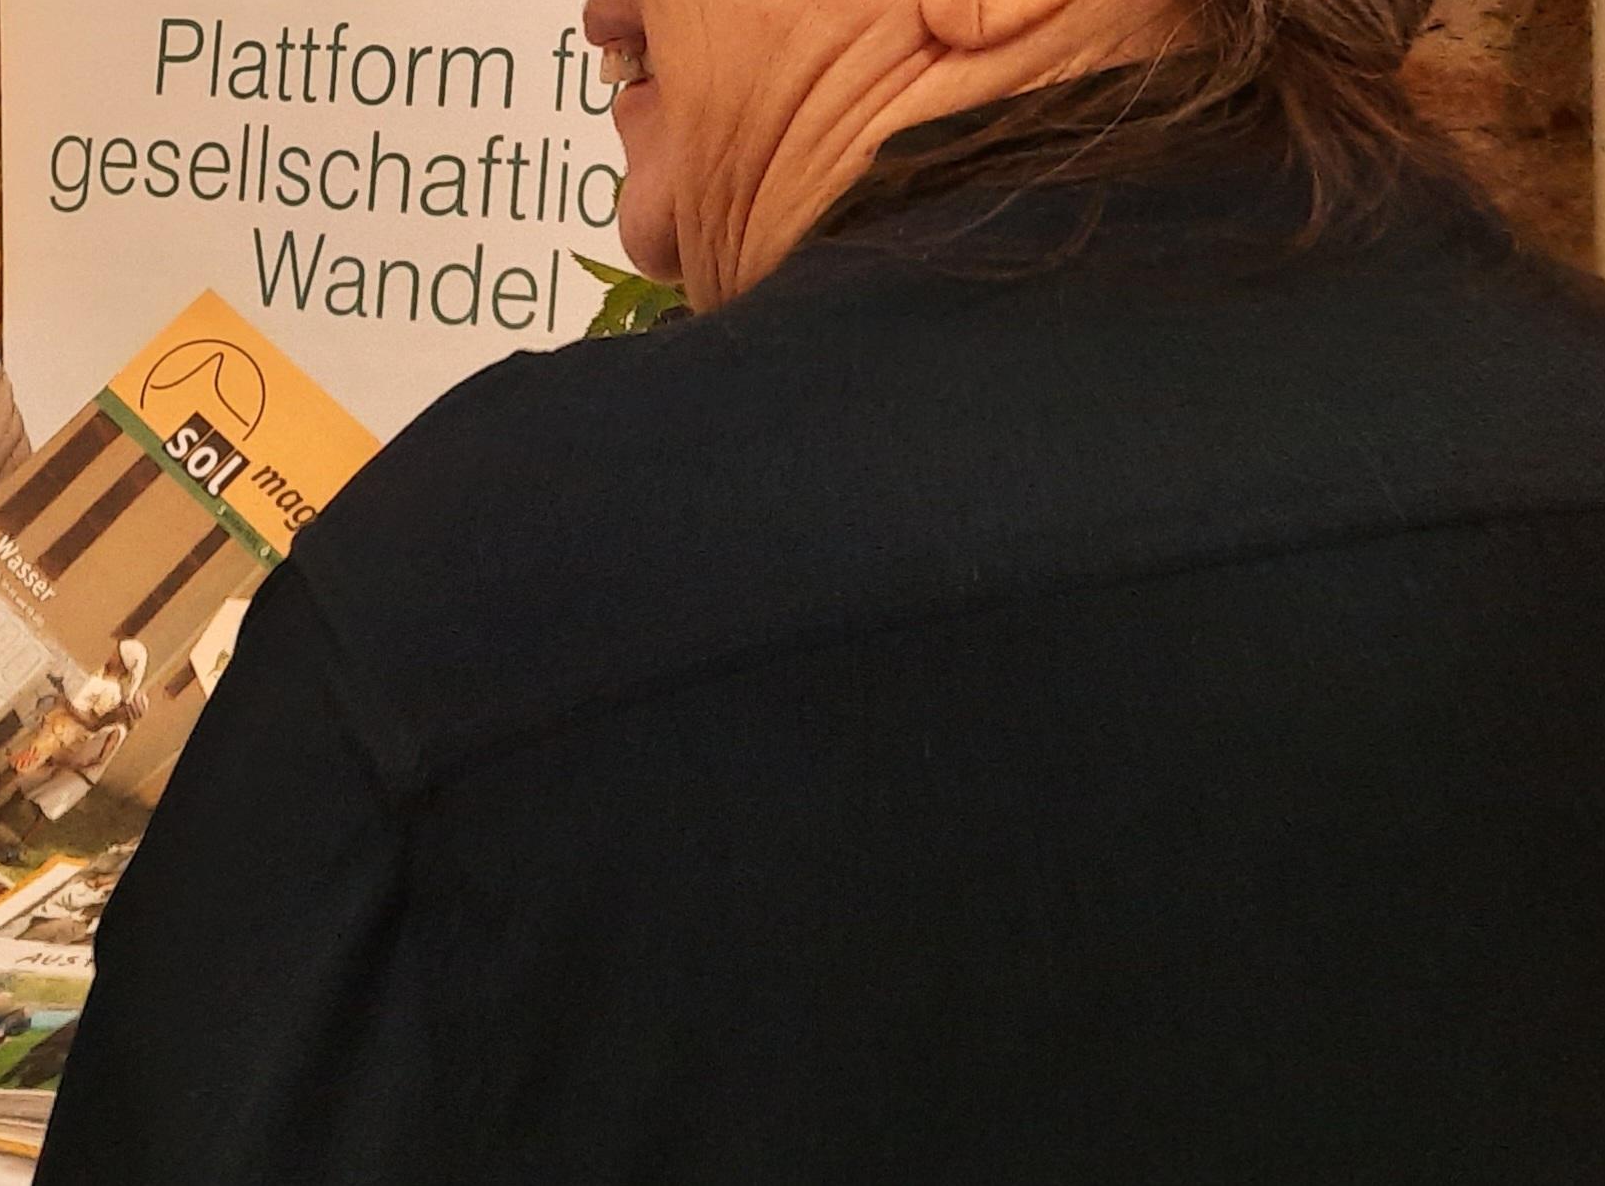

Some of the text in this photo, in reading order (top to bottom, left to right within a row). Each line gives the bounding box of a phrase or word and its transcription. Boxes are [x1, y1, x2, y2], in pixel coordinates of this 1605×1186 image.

[155, 18, 515, 110] Plattform
[49, 123, 619, 228] gesellschaftlic
[253, 227, 560, 333] Wandel
[164, 427, 244, 497] sol
[251, 465, 318, 532] mag
[15, 952, 93, 967] AUS
